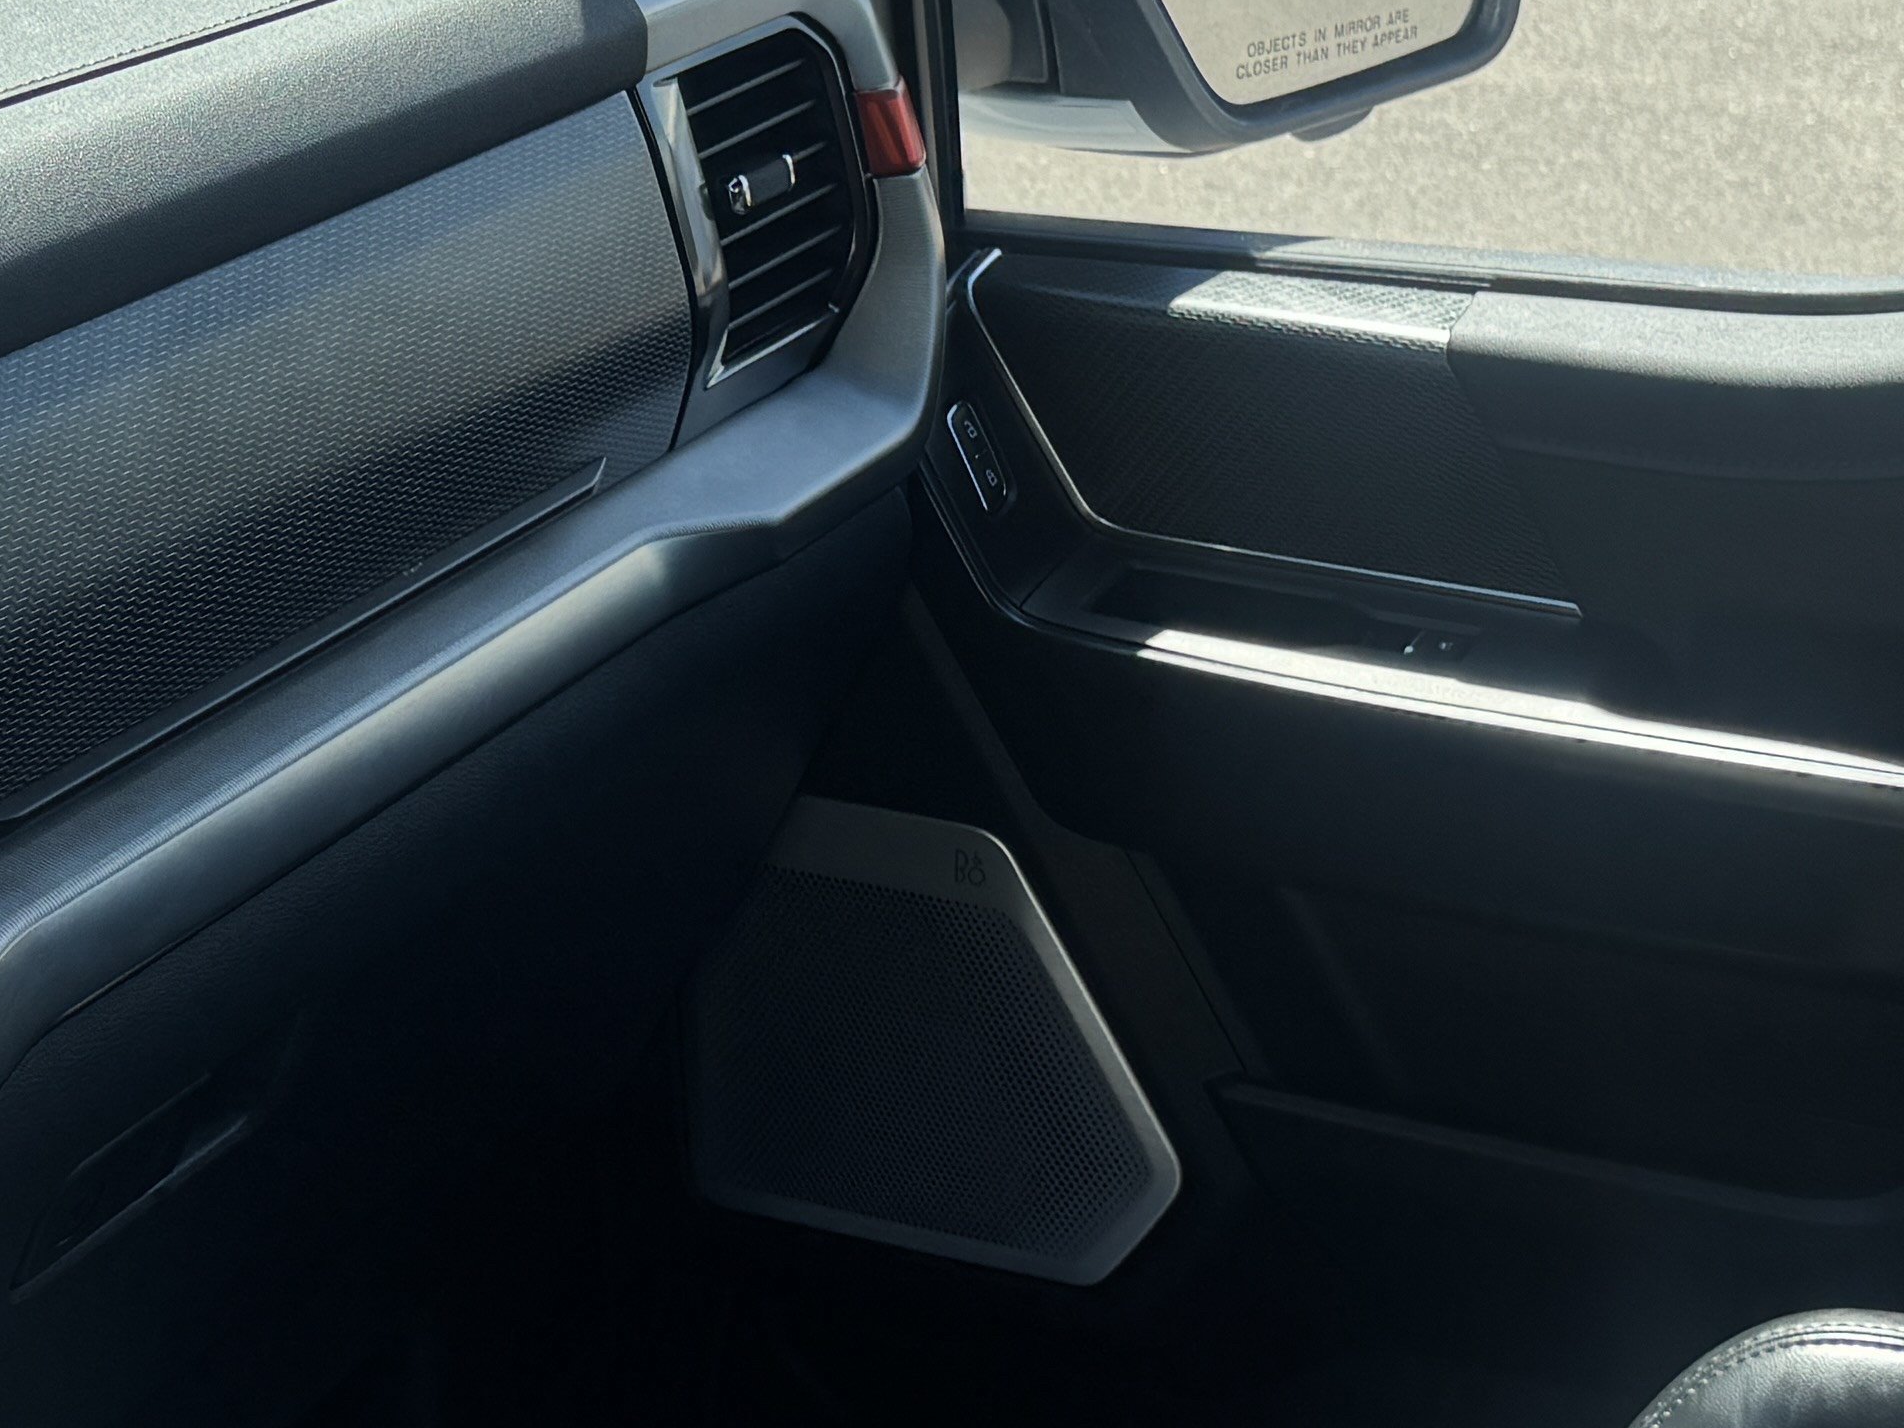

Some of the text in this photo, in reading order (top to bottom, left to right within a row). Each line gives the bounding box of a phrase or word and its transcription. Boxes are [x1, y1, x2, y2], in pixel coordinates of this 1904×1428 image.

[1235, 25, 1419, 81] CLOSER THAN THEY APPEAR
[1246, 8, 1411, 58] OBJECTS IN MIRROR ARE
